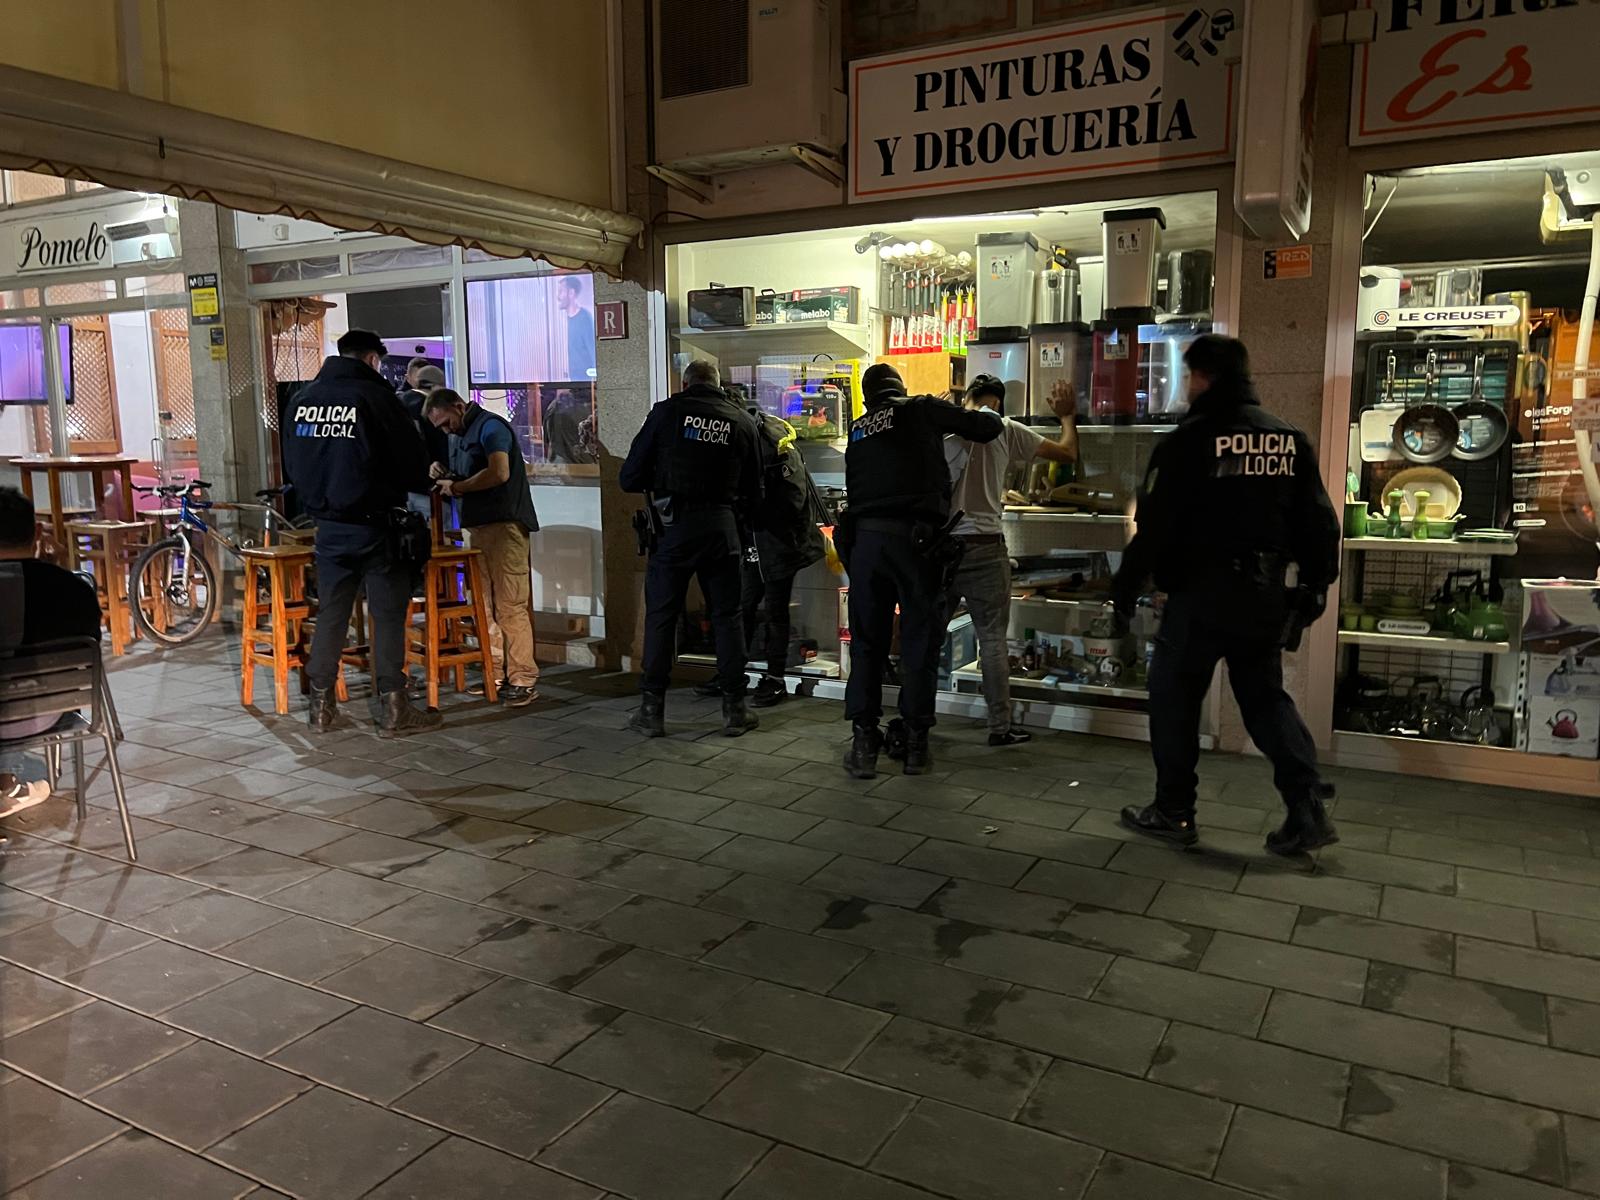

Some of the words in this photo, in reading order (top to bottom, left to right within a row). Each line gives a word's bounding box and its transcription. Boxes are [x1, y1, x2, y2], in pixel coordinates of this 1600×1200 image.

[913, 37, 1151, 113] PINTURAS
[1386, 29, 1533, 122] Es
[874, 136, 902, 177] Y
[913, 86, 1197, 172] DROGUERÍA
[18, 222, 107, 268] Pomelo
[604, 311, 616, 329] R
[1398, 312, 1420, 322] LE
[1423, 310, 1508, 321] CREUSET
[294, 406, 356, 423] POLICIA
[684, 416, 731, 434] POLICIA
[852, 407, 894, 432] POLICIA
[313, 424, 356, 438] LOCAL
[697, 429, 729, 445] LOCAL
[863, 417, 894, 438] LOCAL
[1216, 433, 1297, 458] POLICIA
[1244, 455, 1296, 476] LOCAL
